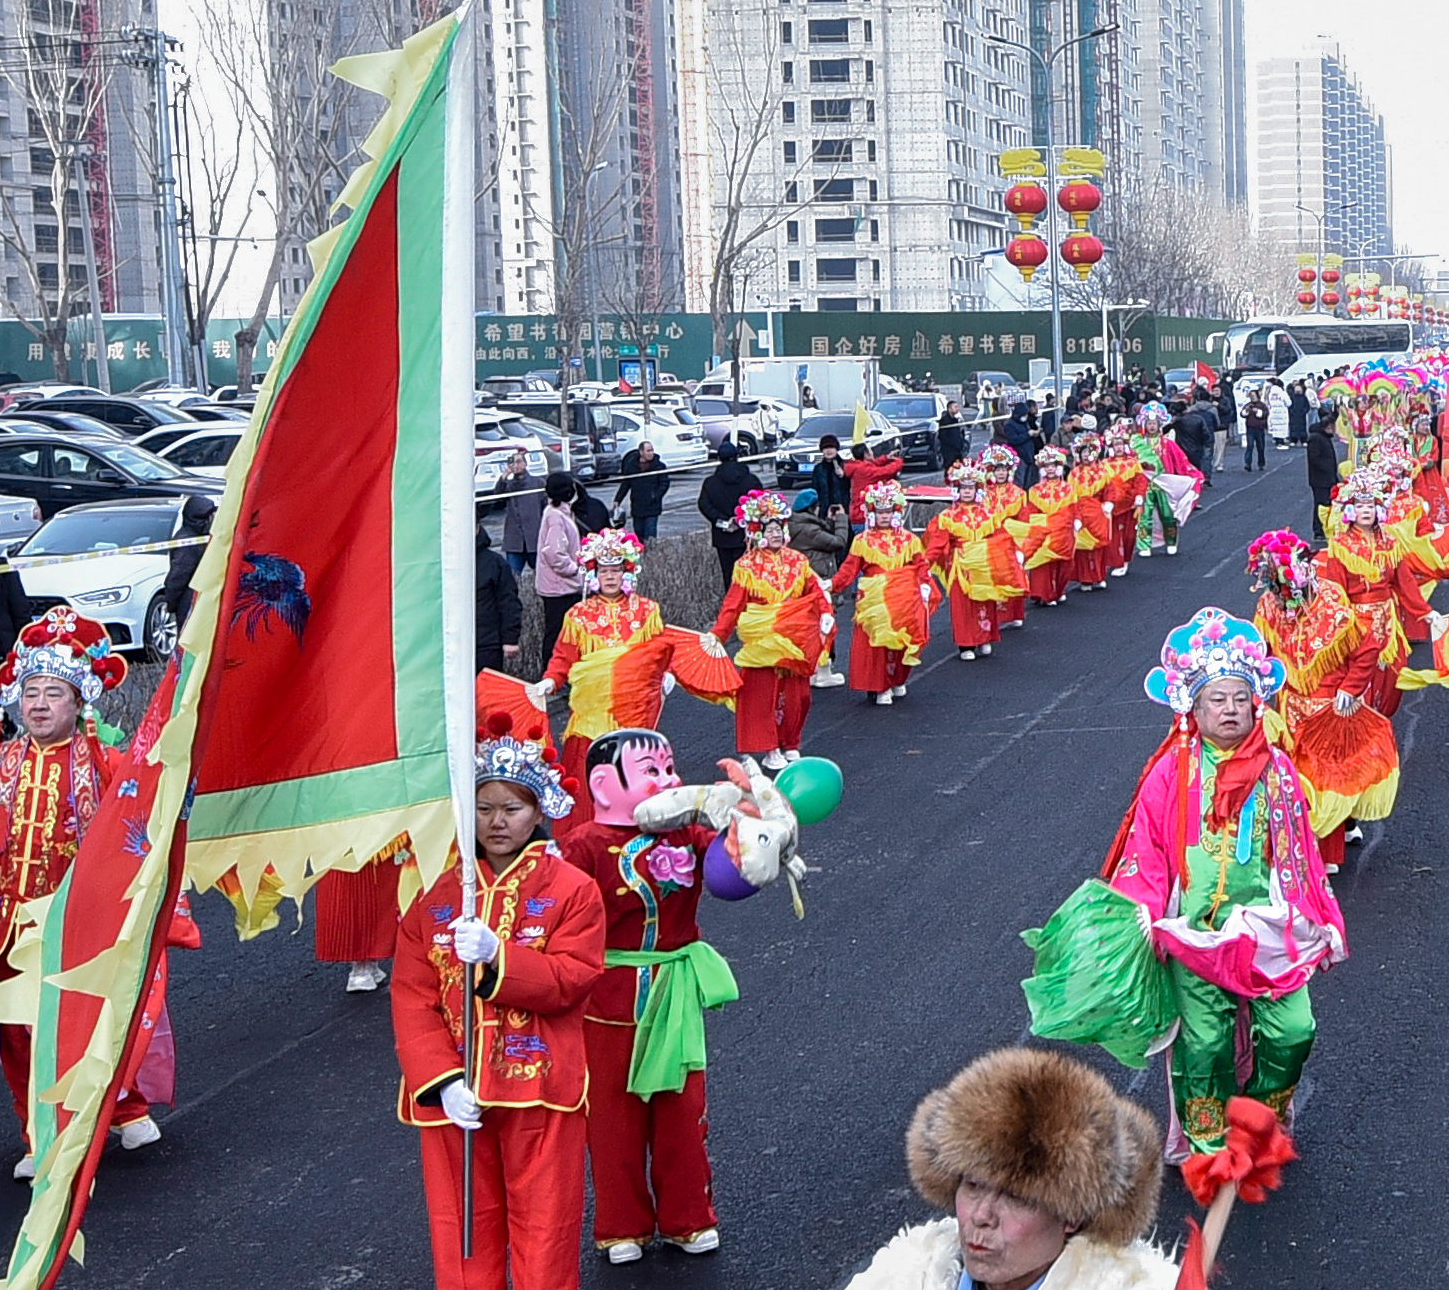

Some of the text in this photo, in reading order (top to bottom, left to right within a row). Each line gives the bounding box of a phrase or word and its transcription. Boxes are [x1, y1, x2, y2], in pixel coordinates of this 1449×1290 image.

[810, 333, 1037, 356] 国企好房 希望书香园
